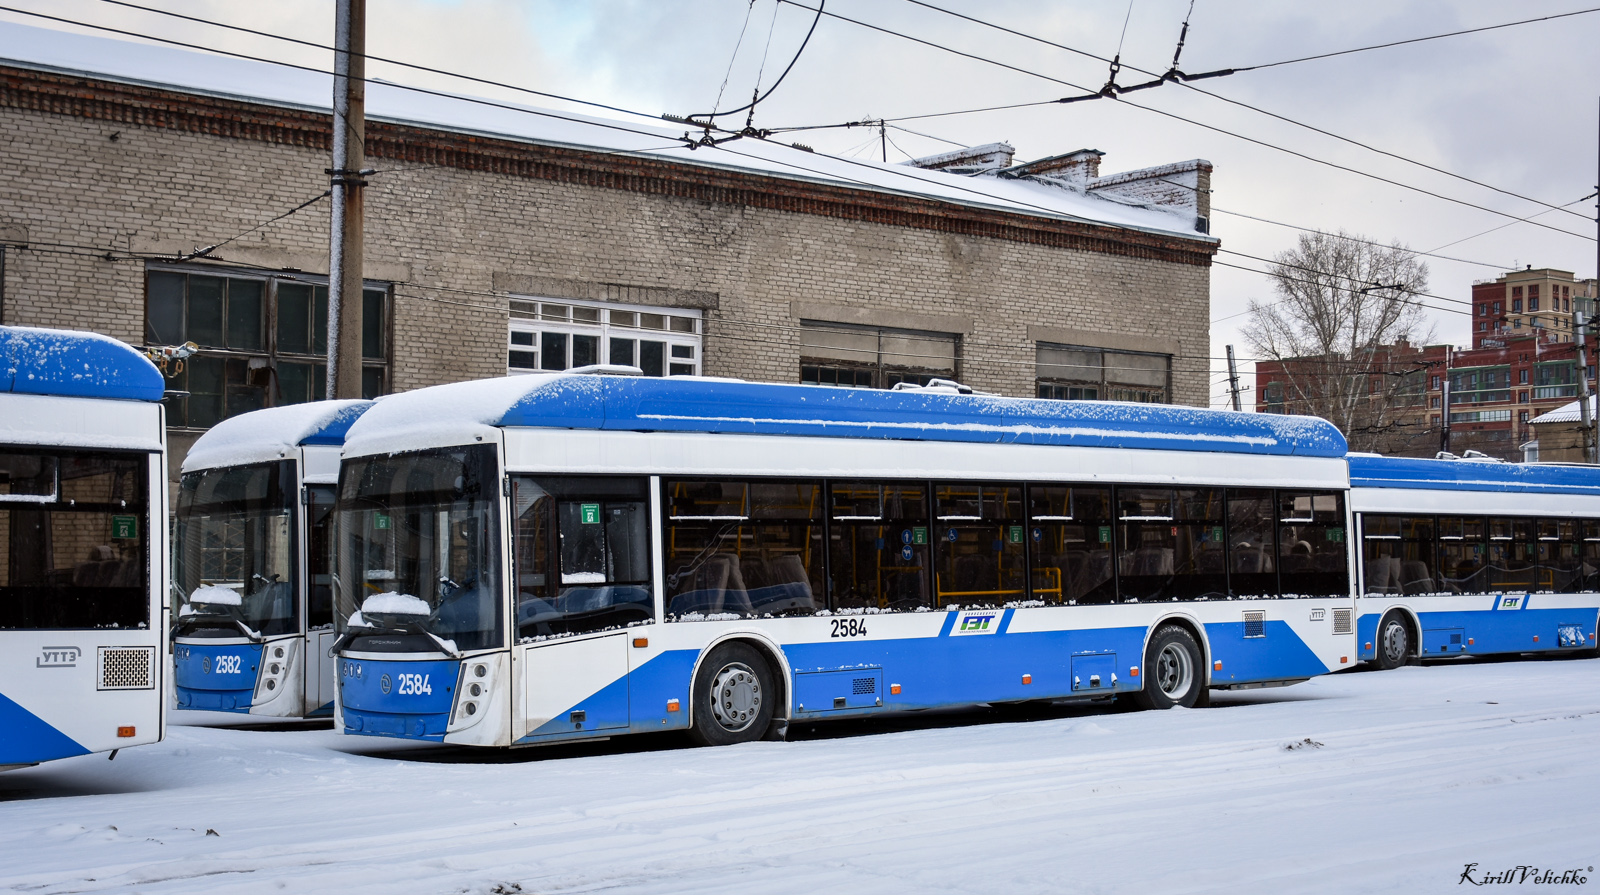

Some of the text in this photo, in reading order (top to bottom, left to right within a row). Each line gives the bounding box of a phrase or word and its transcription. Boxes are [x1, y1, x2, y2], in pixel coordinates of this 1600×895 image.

[830, 618, 867, 638] 2584
[960, 615, 996, 631] ГЭТ
[42, 651, 77, 663] УТТЗ
[215, 655, 241, 674] 2582
[398, 673, 432, 695] 2584
